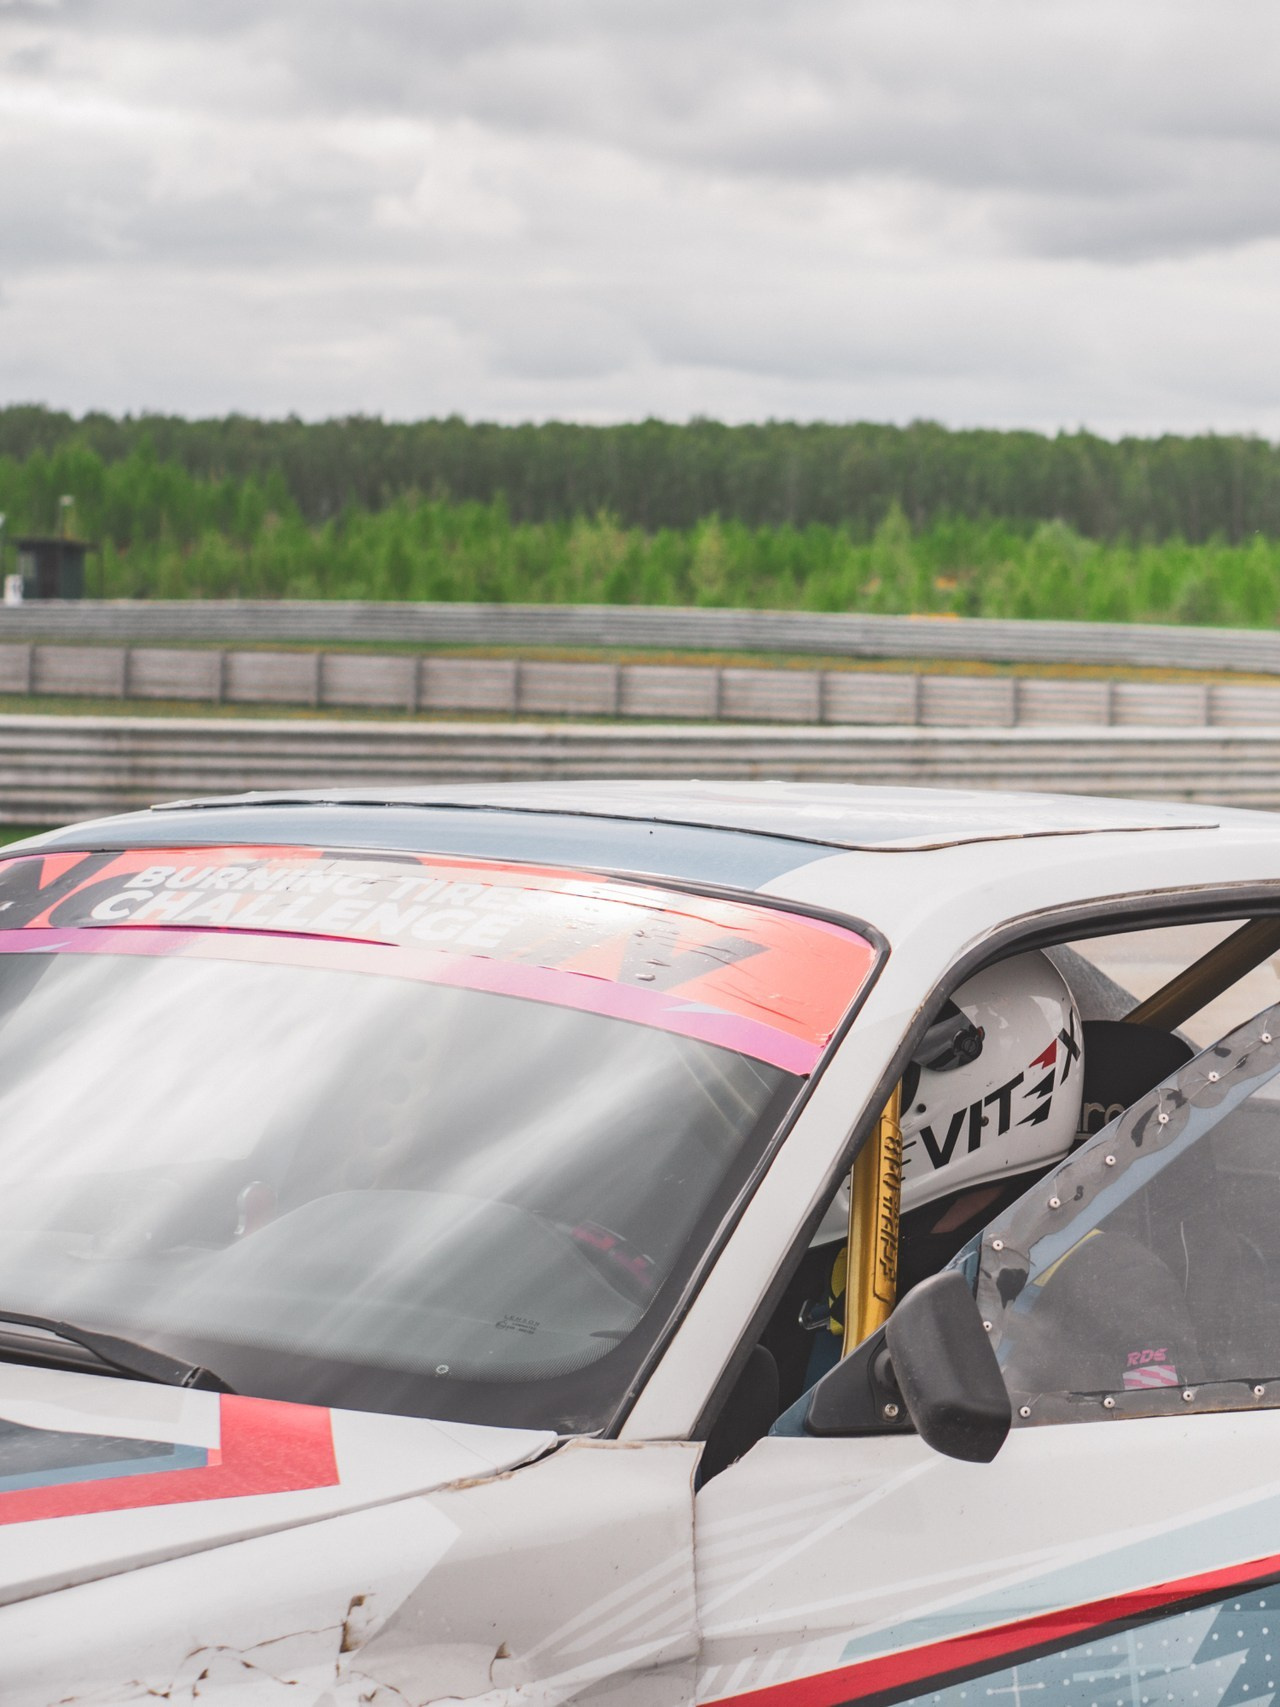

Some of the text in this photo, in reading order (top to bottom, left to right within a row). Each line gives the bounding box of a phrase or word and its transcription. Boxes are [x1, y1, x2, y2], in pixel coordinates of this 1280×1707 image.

[123, 865, 540, 912] BURNING TIRES
[90, 890, 524, 948] CHALLENGE
